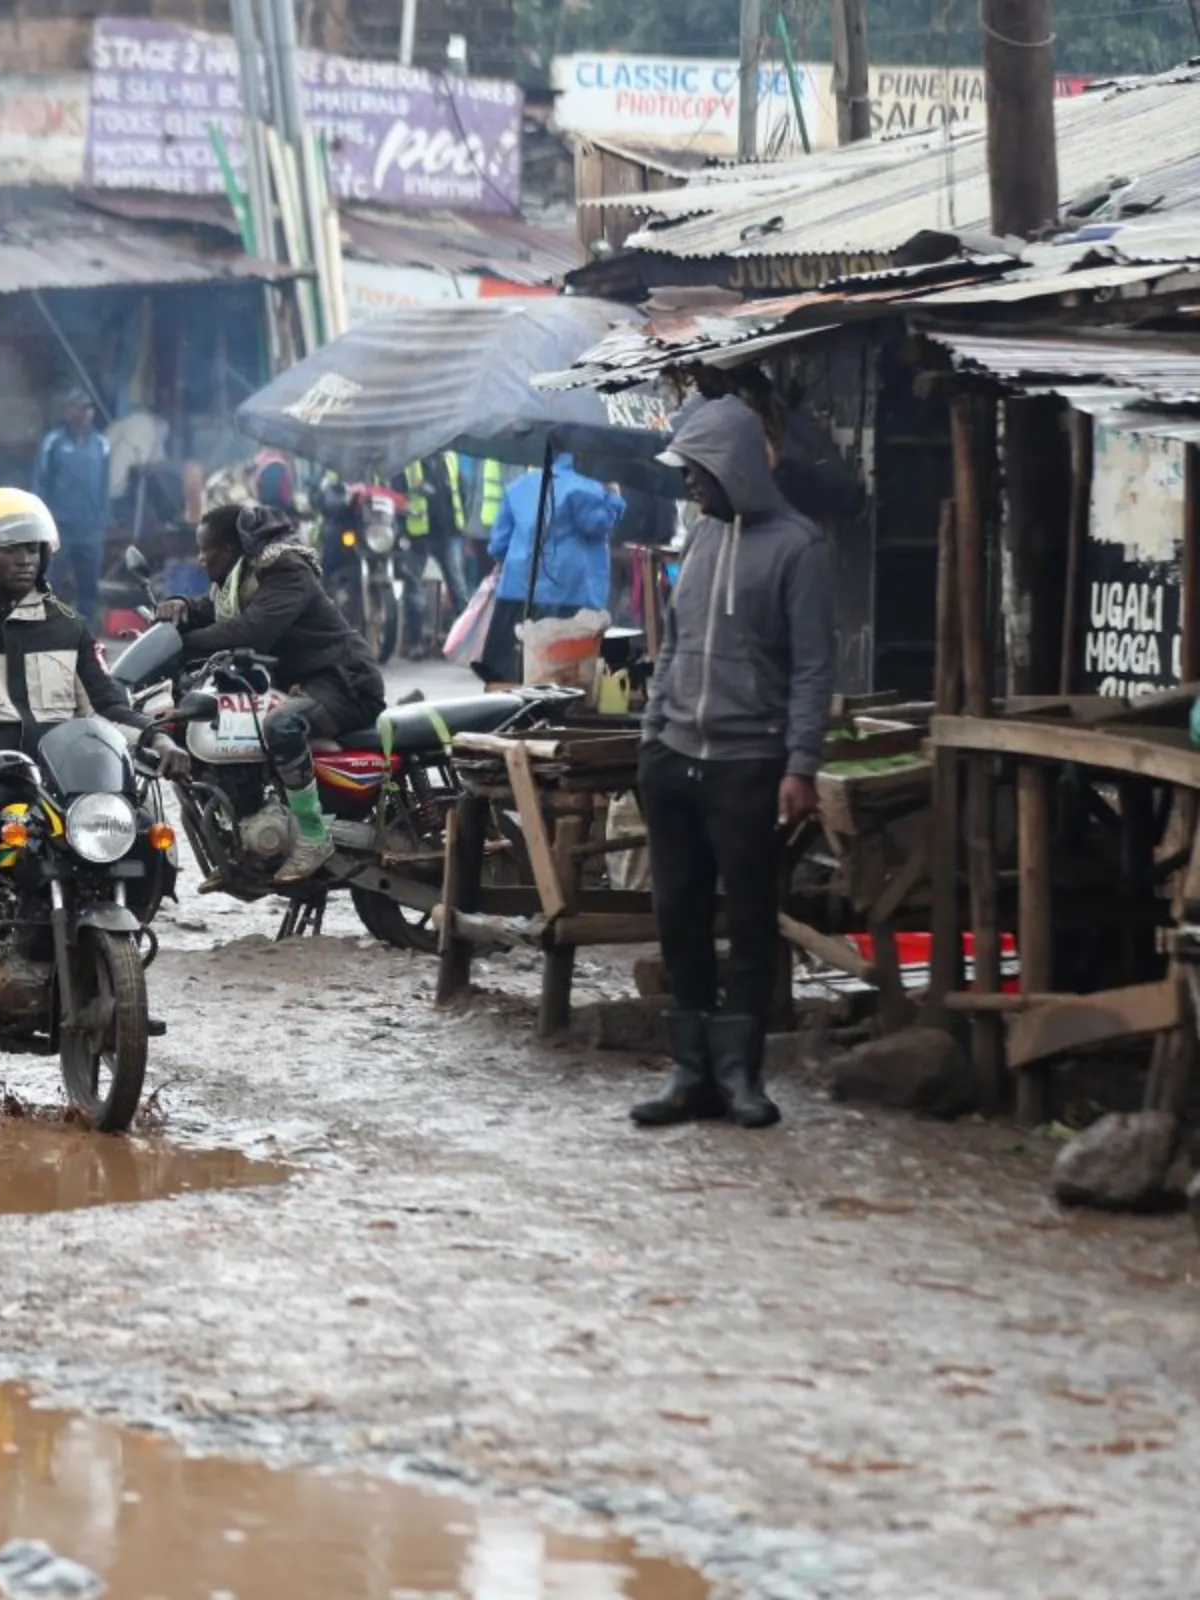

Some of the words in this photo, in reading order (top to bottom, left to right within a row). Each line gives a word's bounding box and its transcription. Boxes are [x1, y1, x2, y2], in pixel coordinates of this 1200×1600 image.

[95, 37, 177, 72] STAGE
[180, 42, 202, 75] 2
[576, 62, 701, 94] CLASSIC
[712, 67, 806, 97] CBER
[616, 89, 736, 120] PHOTOCOPY
[1085, 631, 1161, 675] MBOGA
